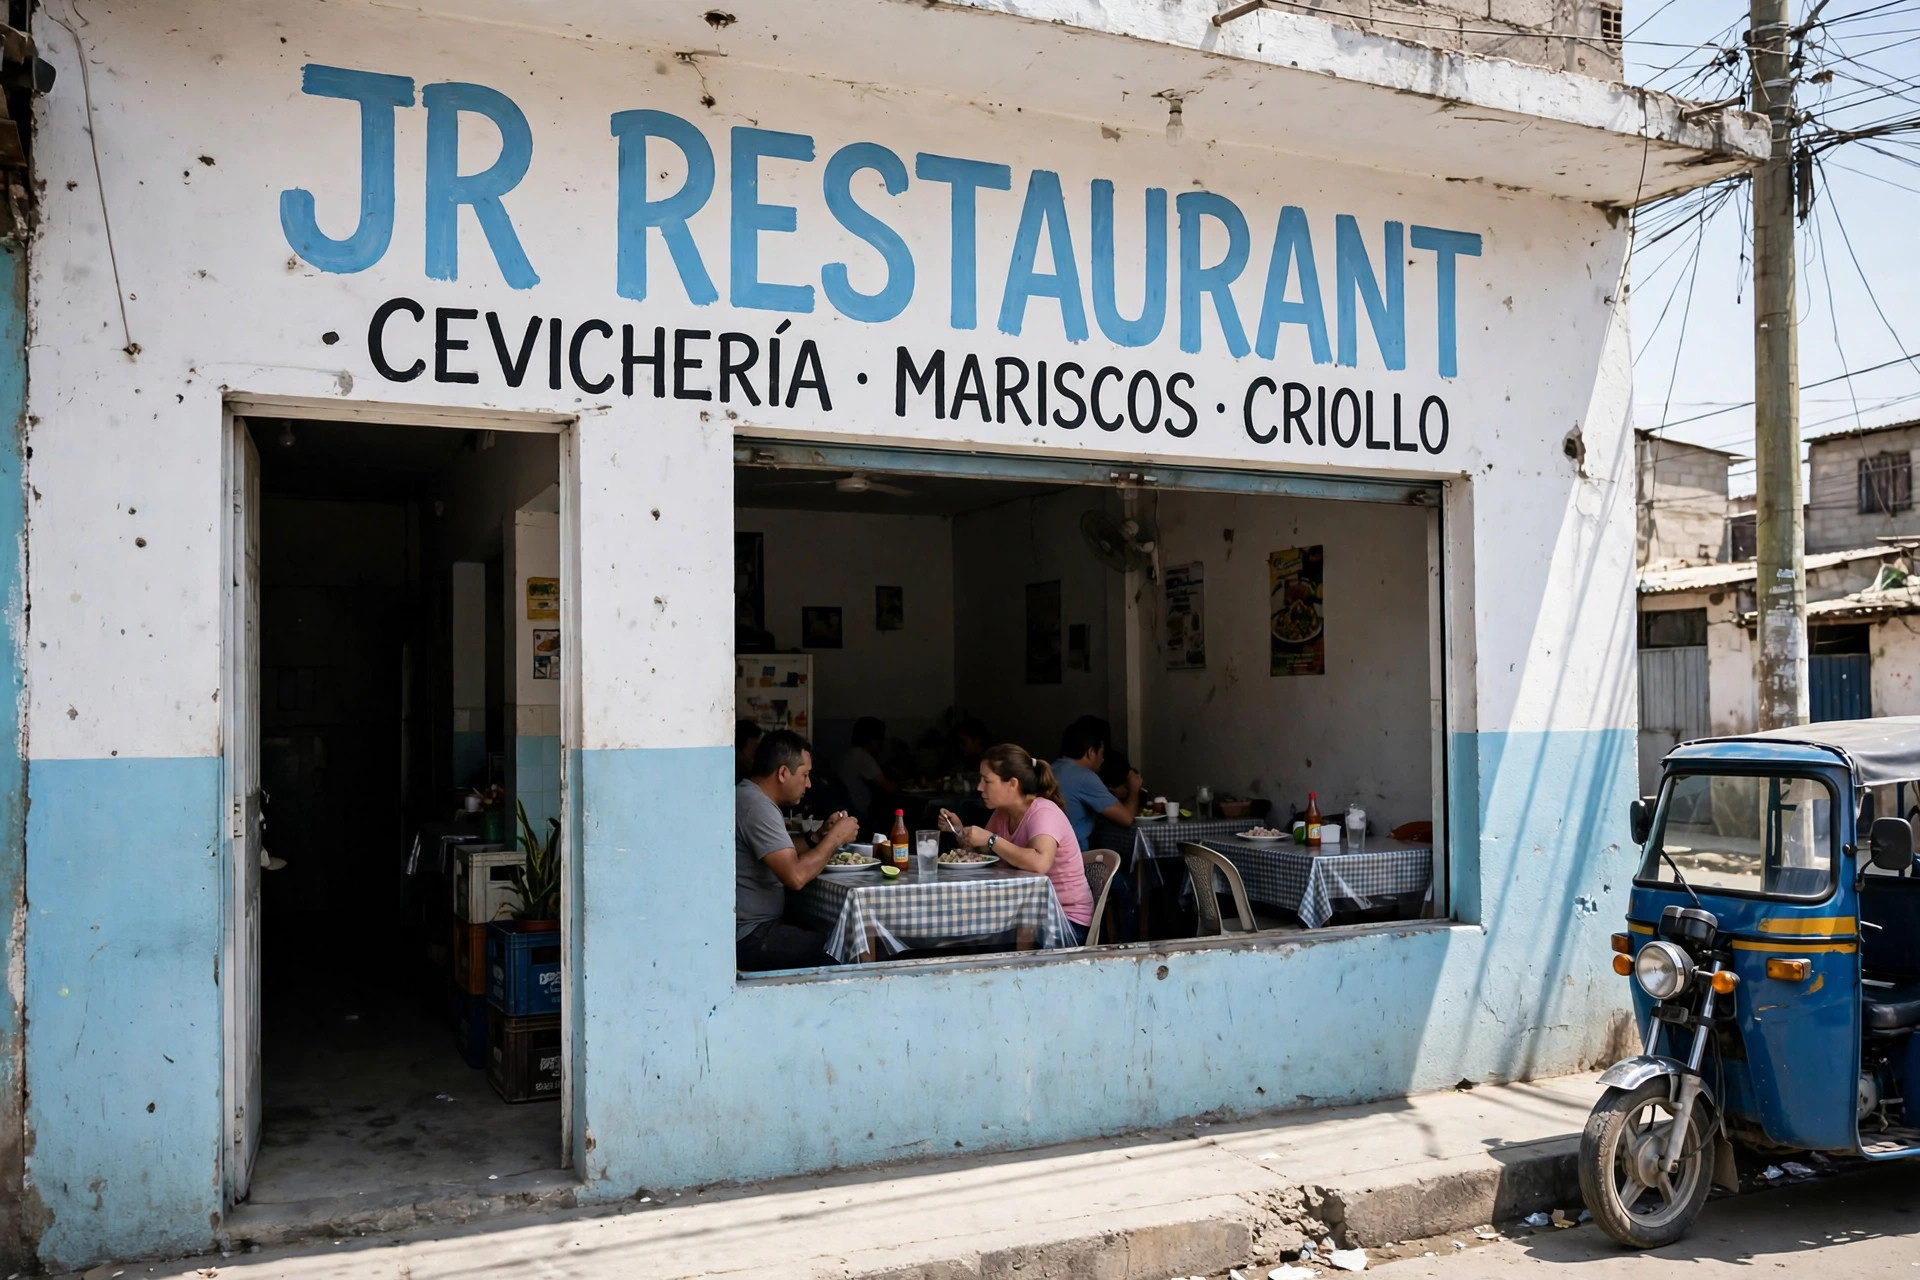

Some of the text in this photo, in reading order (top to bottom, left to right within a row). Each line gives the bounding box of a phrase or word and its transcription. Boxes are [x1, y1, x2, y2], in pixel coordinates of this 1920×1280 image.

[279, 63, 1482, 378] JR RESTAURANT
[368, 297, 832, 412] CEVICHERÍA
[895, 346, 1198, 438] MARISCOS
[1243, 376, 1449, 455] CRIOLLO
